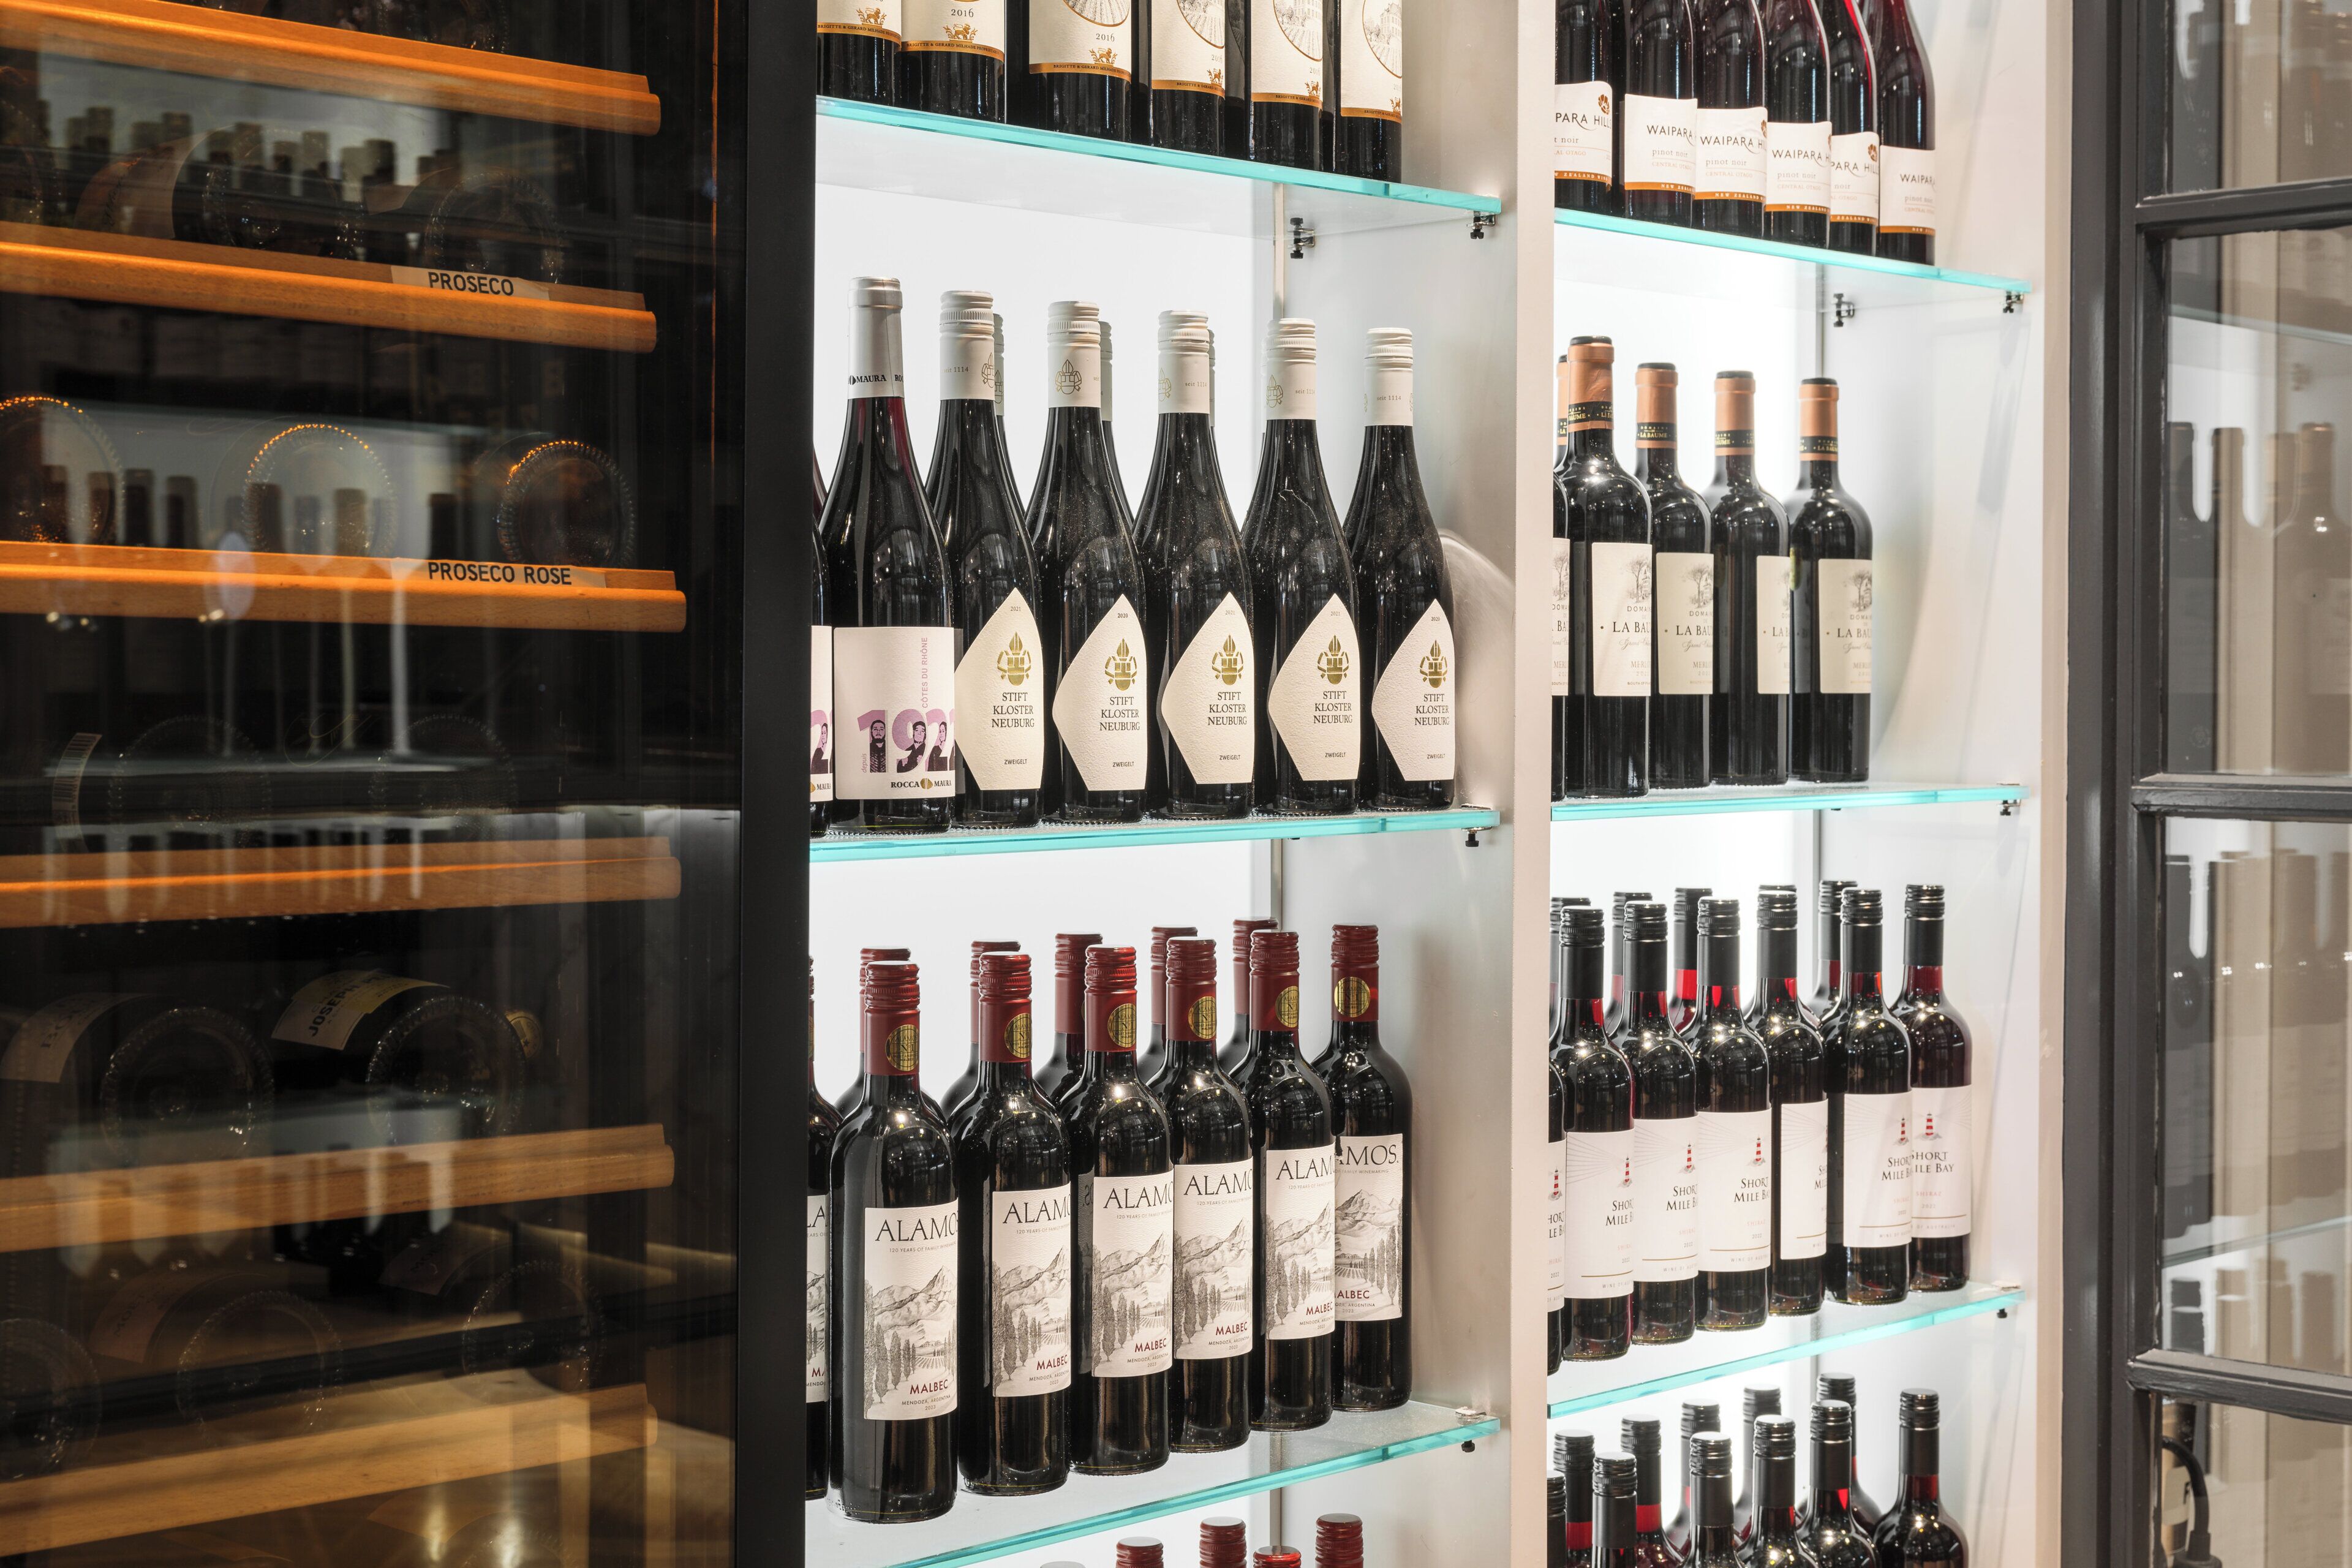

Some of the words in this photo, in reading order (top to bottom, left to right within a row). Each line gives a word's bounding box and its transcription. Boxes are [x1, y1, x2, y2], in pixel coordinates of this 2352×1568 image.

[951, 8, 974, 18] 2016
[1096, 33, 1115, 42] 2016
[1556, 113, 1588, 130] PARA
[1647, 125, 1692, 144] WAIPARA
[1700, 136, 1754, 154] WAIPARA
[1772, 149, 1822, 167] WAIPARA
[428, 271, 514, 297] PROSECO
[428, 561, 515, 582] PROSECO
[524, 566, 571, 586] ROSE
[1613, 621, 1629, 633] LA
[1635, 622, 1651, 633] BAU
[1676, 625, 1692, 636] LA
[1696, 625, 1713, 636] BAU
[1773, 627, 1784, 637] LA
[1838, 628, 1852, 638] LA
[921, 666, 928, 680] DU
[1002, 692, 1028, 701] STIFT
[1218, 692, 1241, 701] STIFT
[1323, 690, 1347, 699] STIFT
[1423, 693, 1444, 702] STIFT
[1110, 696, 1134, 706] STIFT
[993, 705, 1033, 715] KLOSTER
[1209, 704, 1246, 713] KLOSTER
[1315, 703, 1352, 712] KLOSTER
[1416, 706, 1449, 714] KLOSTER
[1101, 709, 1139, 718] KLOSTER
[1313, 715, 1352, 723] NEUBURG
[992, 718, 1035, 728] NEUBURG
[1099, 722, 1140, 731] NEUBURG
[1208, 717, 1247, 725] NEUBURG
[1415, 717, 1450, 726] NEUBURG
[858, 709, 955, 773] 192
[309, 984, 360, 1037] JOSEPH
[1276, 1154, 1335, 1180] ALAM
[1936, 1163, 1954, 1174] BAY
[1882, 1169, 1904, 1181] MILE
[1734, 1192, 1759, 1202] MILE
[1666, 1200, 1690, 1212] MILE
[1605, 1215, 1628, 1226] MILE
[1306, 1302, 1333, 1316] MALBEC
[1216, 1322, 1248, 1335] MALBEC
[1134, 1338, 1167, 1352] MALBEC
[1036, 1354, 1068, 1370] MALBEC
[910, 1379, 948, 1395] MALBEC
